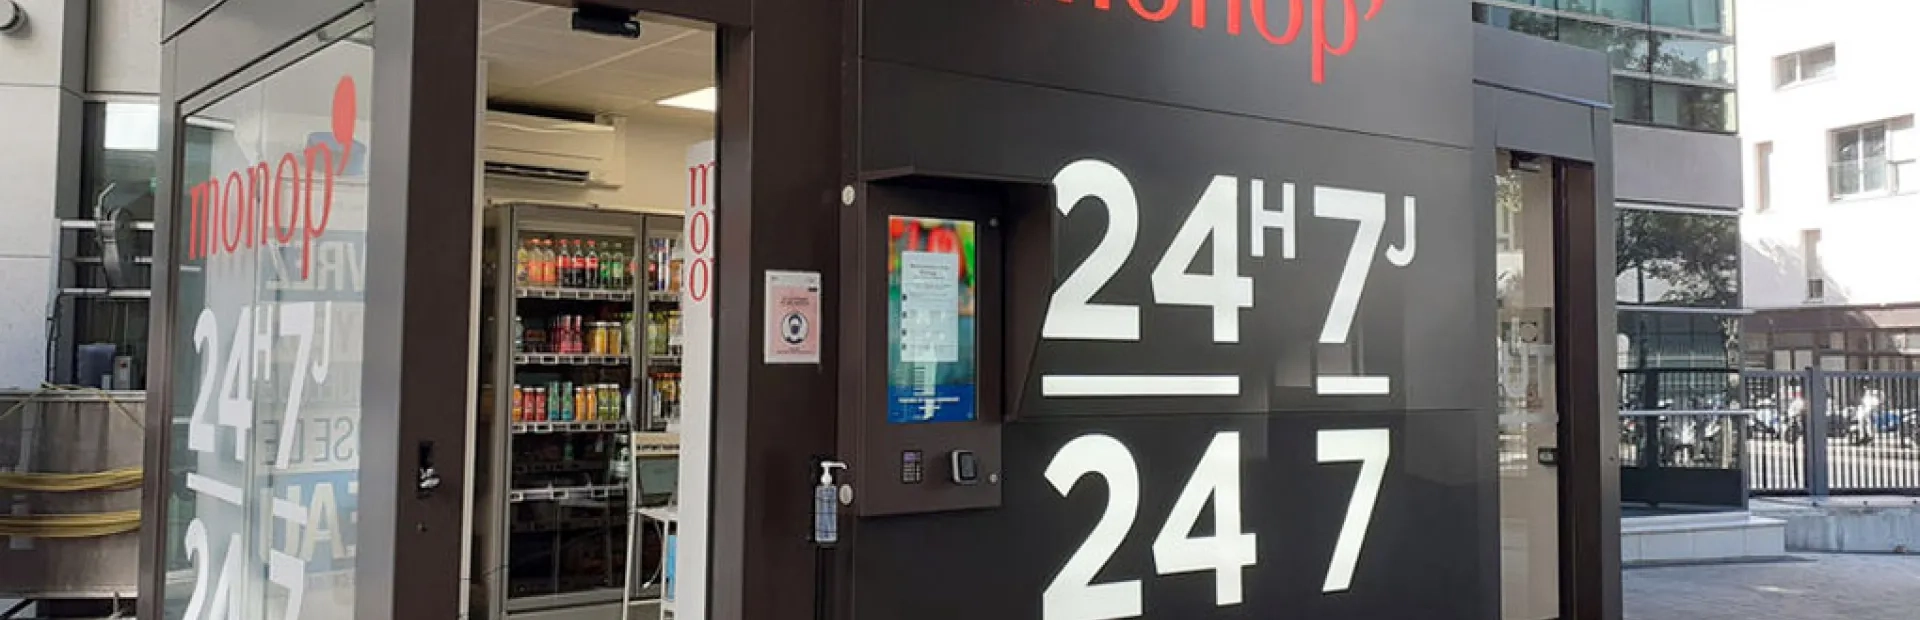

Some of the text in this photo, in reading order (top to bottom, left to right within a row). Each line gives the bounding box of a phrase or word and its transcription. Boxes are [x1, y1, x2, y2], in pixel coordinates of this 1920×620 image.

[182, 518, 243, 620] 24
[1042, 428, 1391, 620] 24 7
